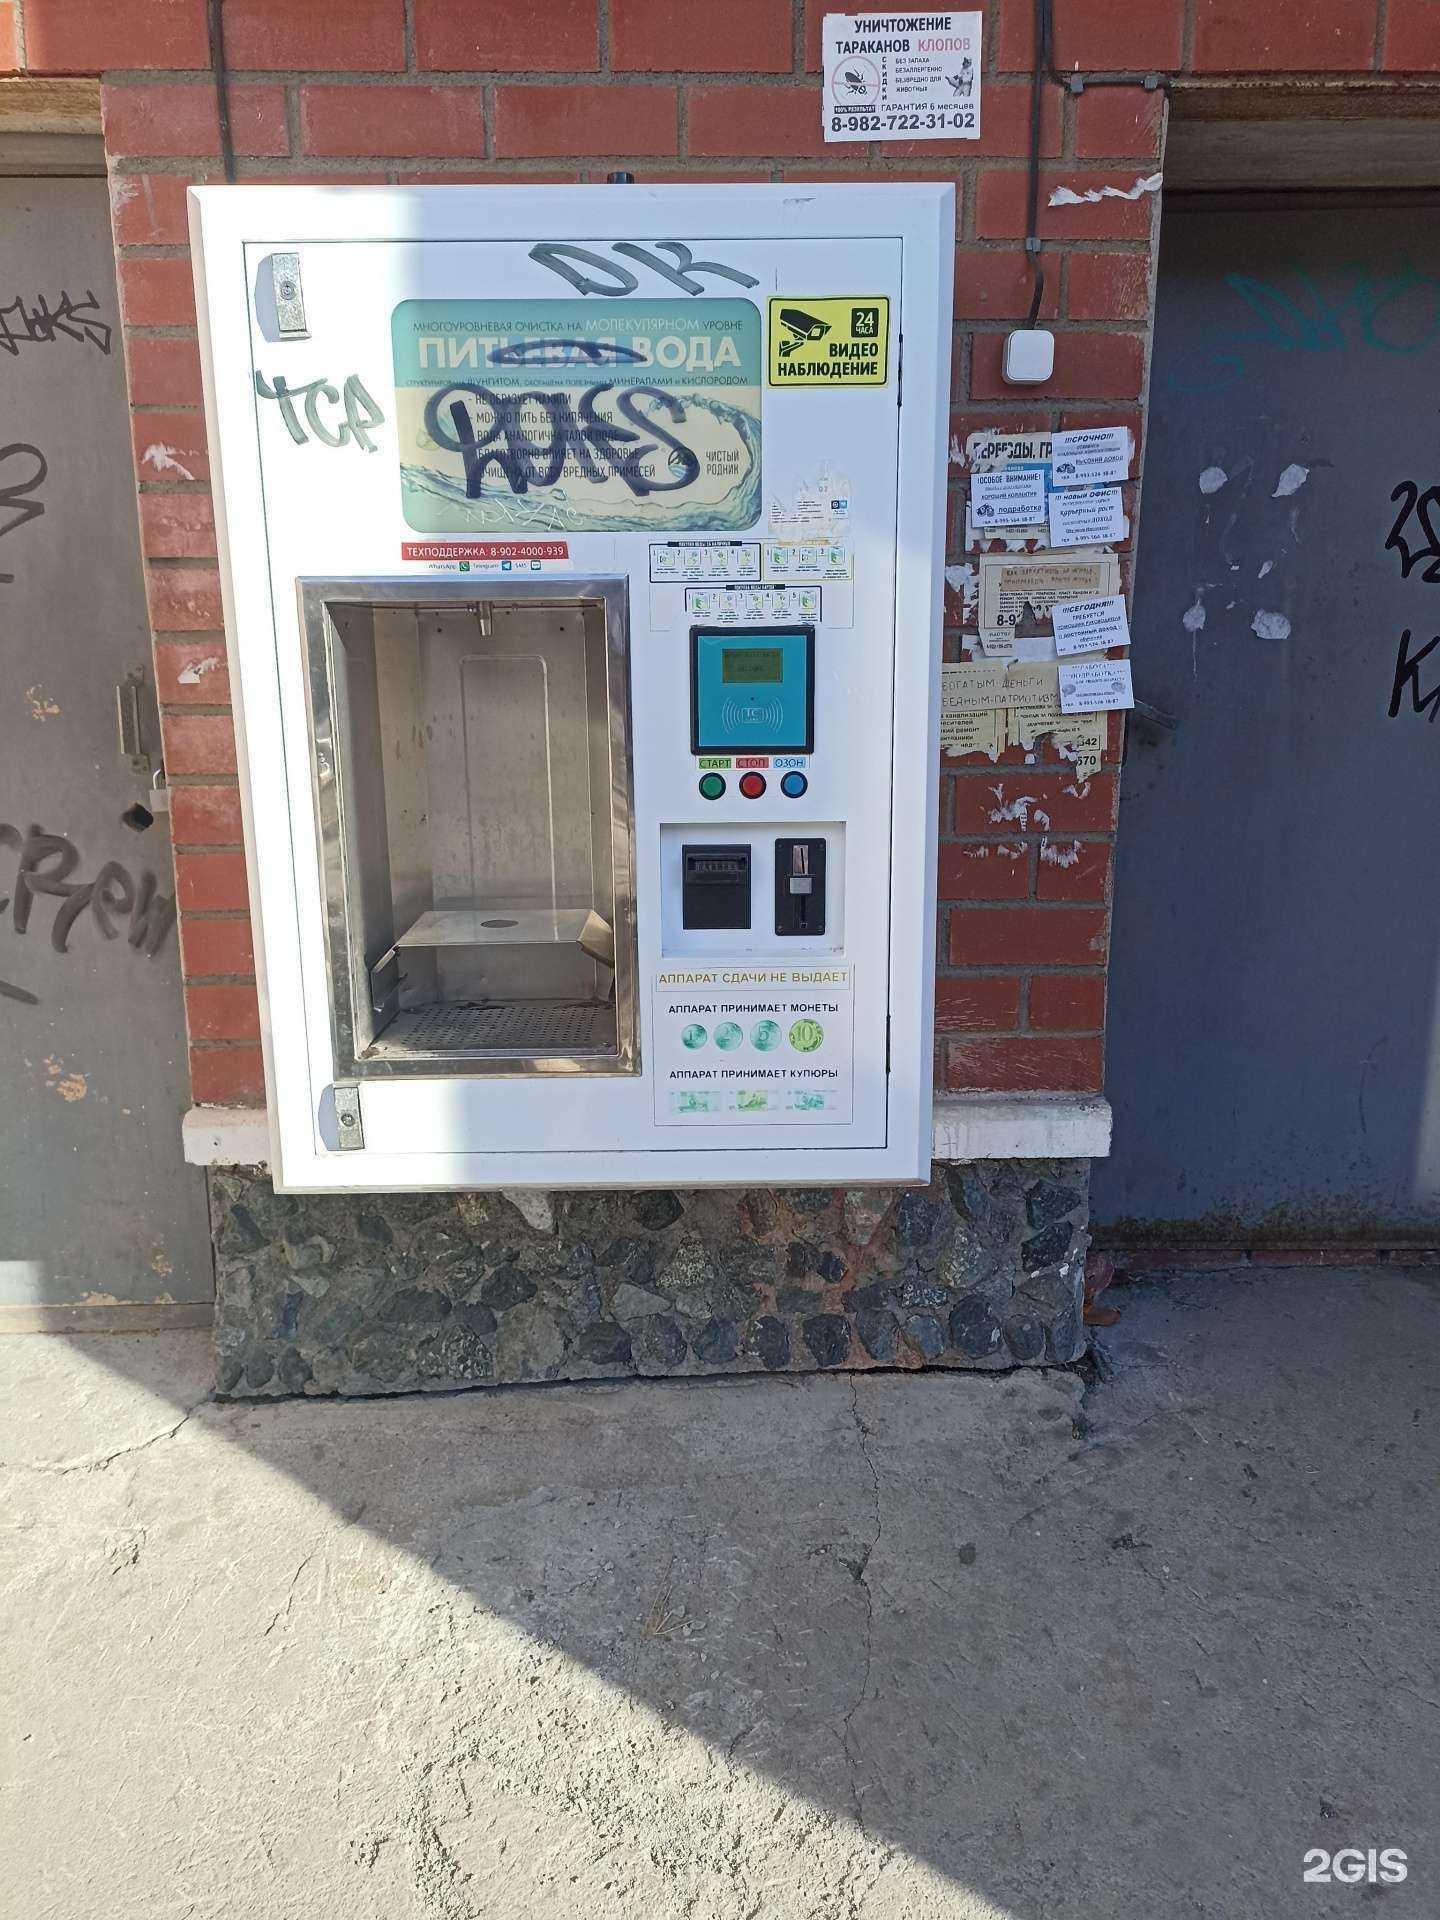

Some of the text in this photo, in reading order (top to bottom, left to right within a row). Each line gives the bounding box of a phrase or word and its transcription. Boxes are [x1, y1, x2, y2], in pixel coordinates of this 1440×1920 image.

[855, 17, 951, 33] УНИЧТОЖЕНИЕ
[836, 38, 970, 54] ТАРАКАНОВ КЛОПОВ
[881, 102, 975, 112] ГАРАНТИЯ 6 месяцев
[831, 113, 975, 132] 8-982-722-31-02
[413, 318, 743, 333] МНОГОУРОВНЕВАЯ ОЧИСТКА НА МОЛЕКУЛЯРНОМ УРОВНЕ
[856, 312, 874, 327] 24
[855, 326, 874, 335] ЧАСА
[632, 335, 742, 373] ВОДА
[829, 343, 879, 360] ВИДЕО
[777, 362, 878, 379] НАБЛЮДЕНИЕ
[608, 376, 673, 386] МИНЕРАЛАМИ
[682, 375, 748, 385] КИСЛОРОДОМ
[514, 412, 537, 424] ПИТЬ
[706, 449, 740, 463] ЧИСТЫЙ
[563, 465, 606, 478] ВРЕДНЫХ
[608, 464, 656, 478] ПРИМЕСЕЙ
[706, 463, 739, 476] РОДНИК
[407, 546, 564, 557] ТЕХПОДДЕРЖКА 8-902-4000-939
[699, 758, 805, 768] СТАРТ СТОП ОЗОН
[659, 972, 848, 985] АППАРАТ СДАЧИ НЕ ВЫДАЕТ
[668, 1003, 839, 1014] АППАРАТ ПРИНИМАЕТ МОНЕТЫ
[669, 1069, 838, 1079] АППАРАТ ПРИНИМАЕТ КУПЮРЫ
